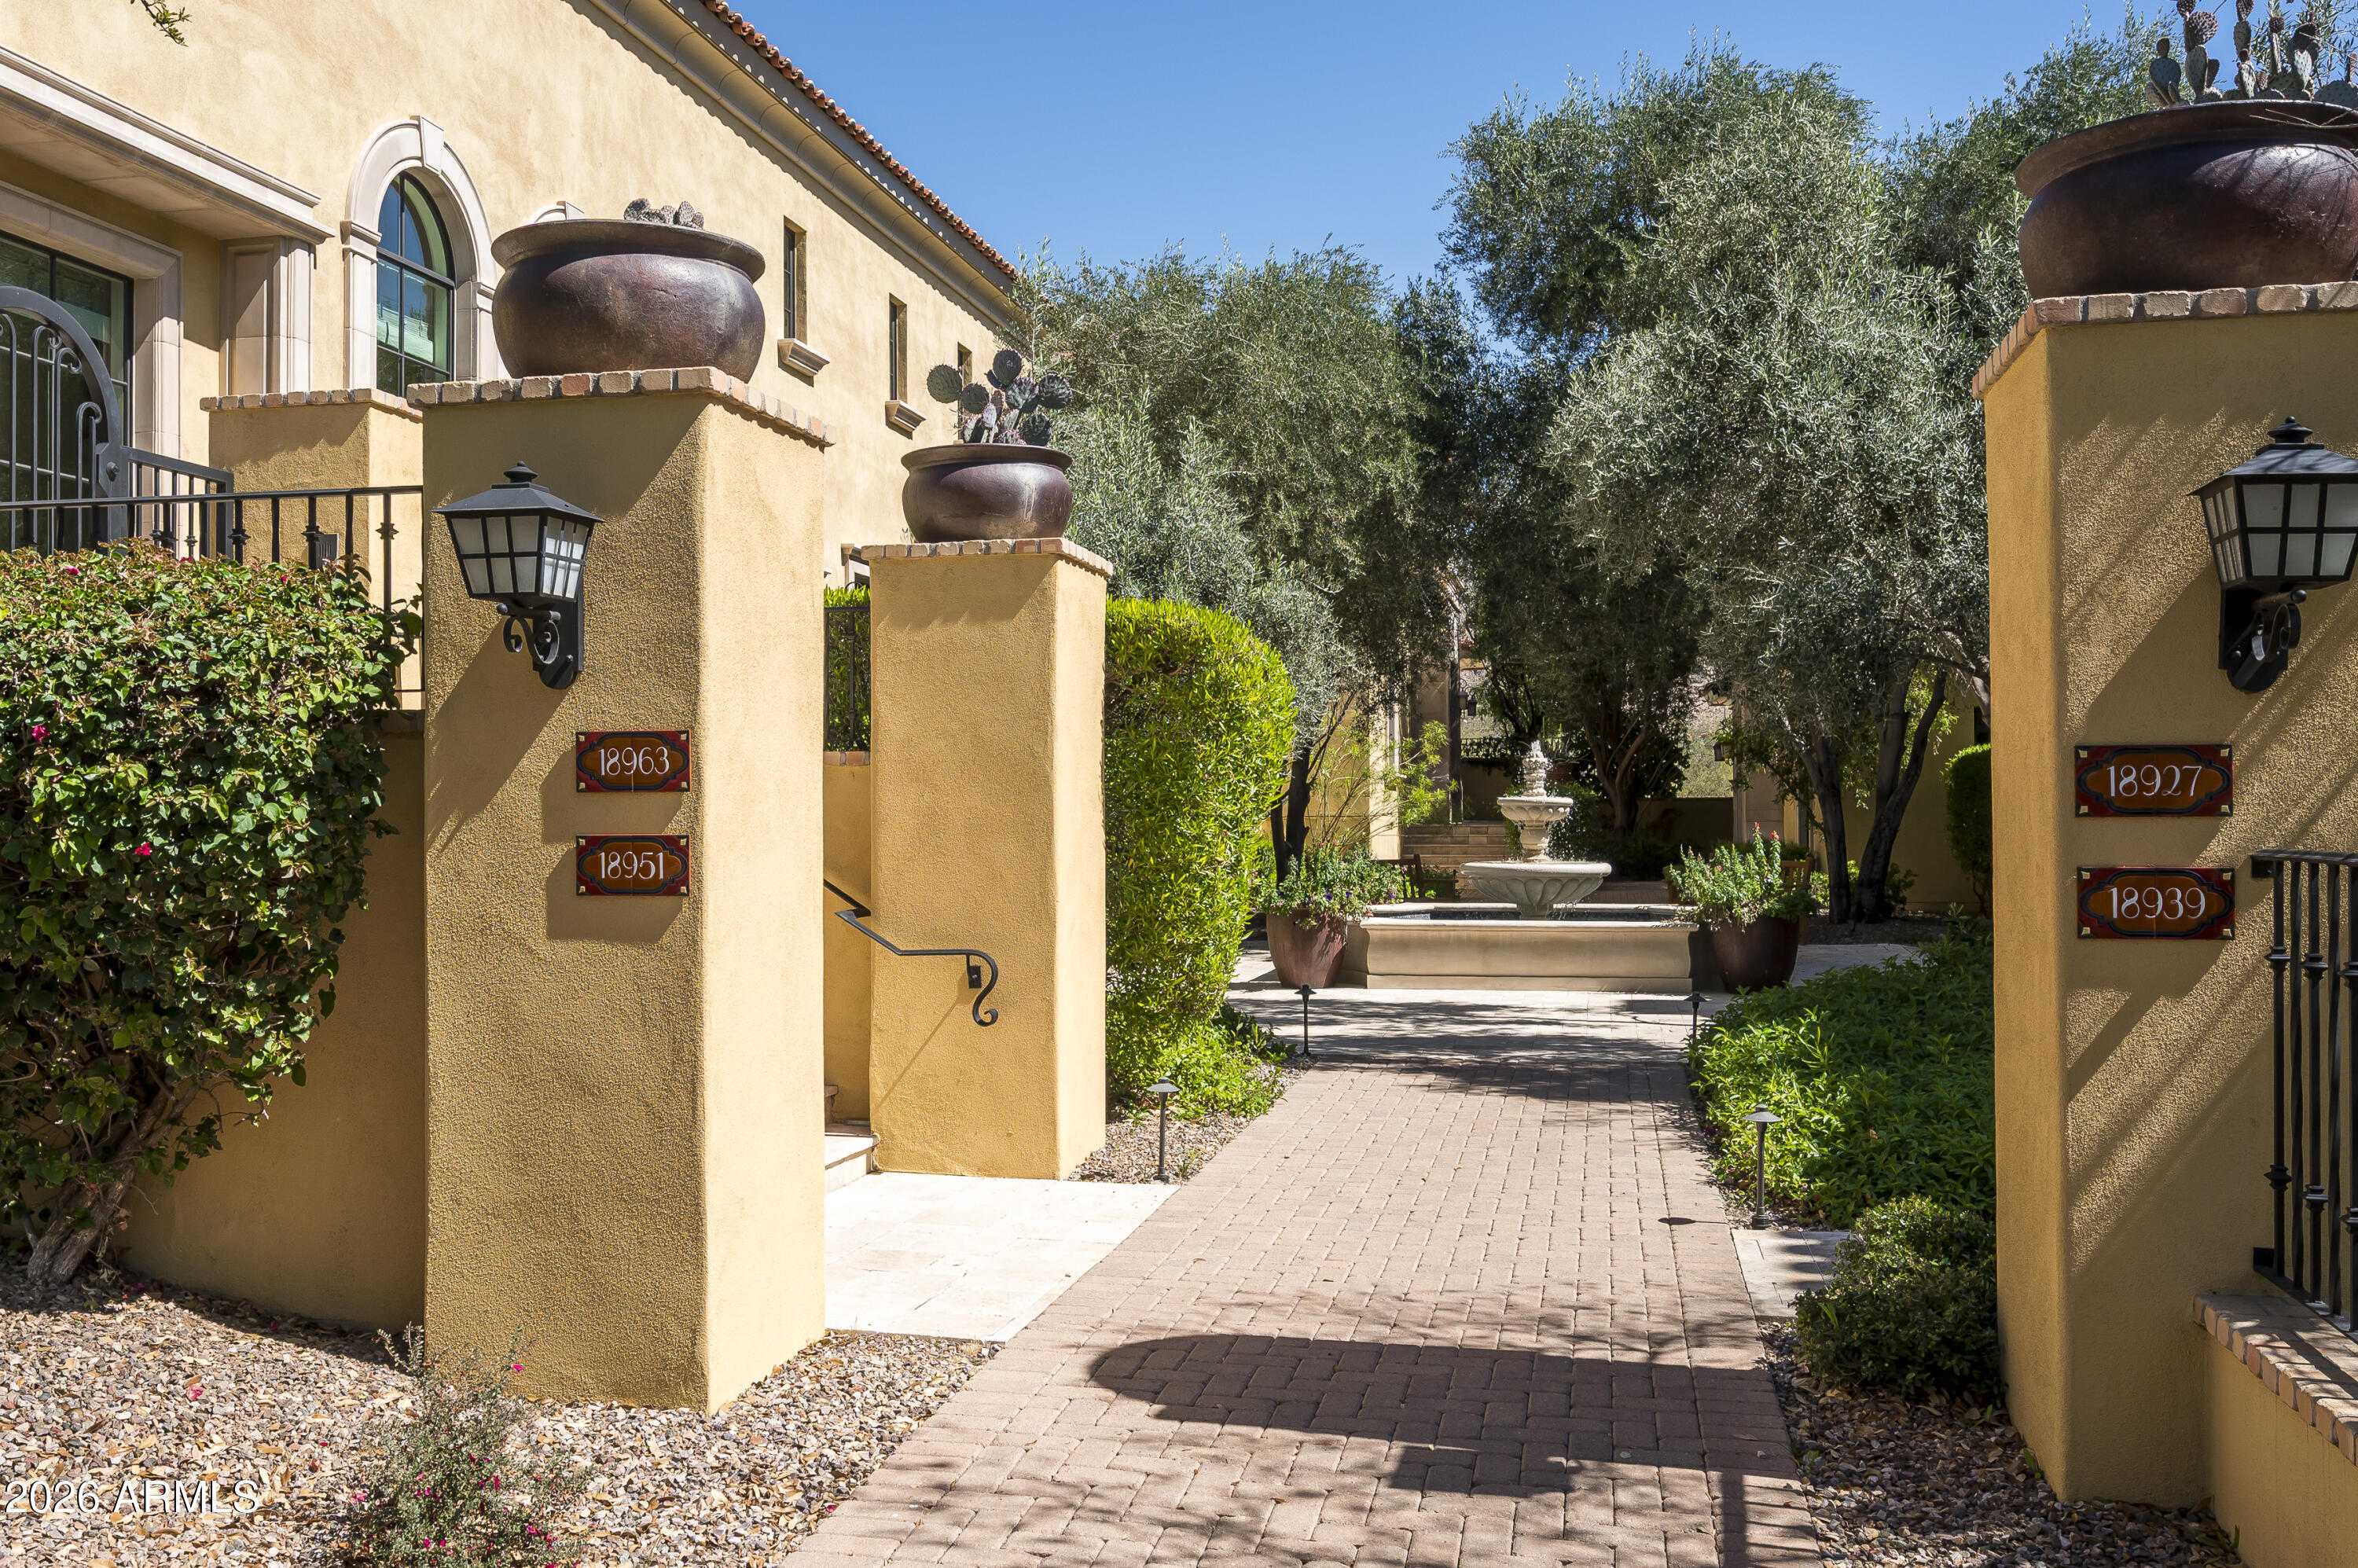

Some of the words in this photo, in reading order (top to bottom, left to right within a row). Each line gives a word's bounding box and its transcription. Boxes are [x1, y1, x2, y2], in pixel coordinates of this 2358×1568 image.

[598, 747, 670, 776] 18963
[2106, 765, 2202, 797] 18927
[598, 851, 663, 879] 18951
[2108, 887, 2206, 920] 18939
